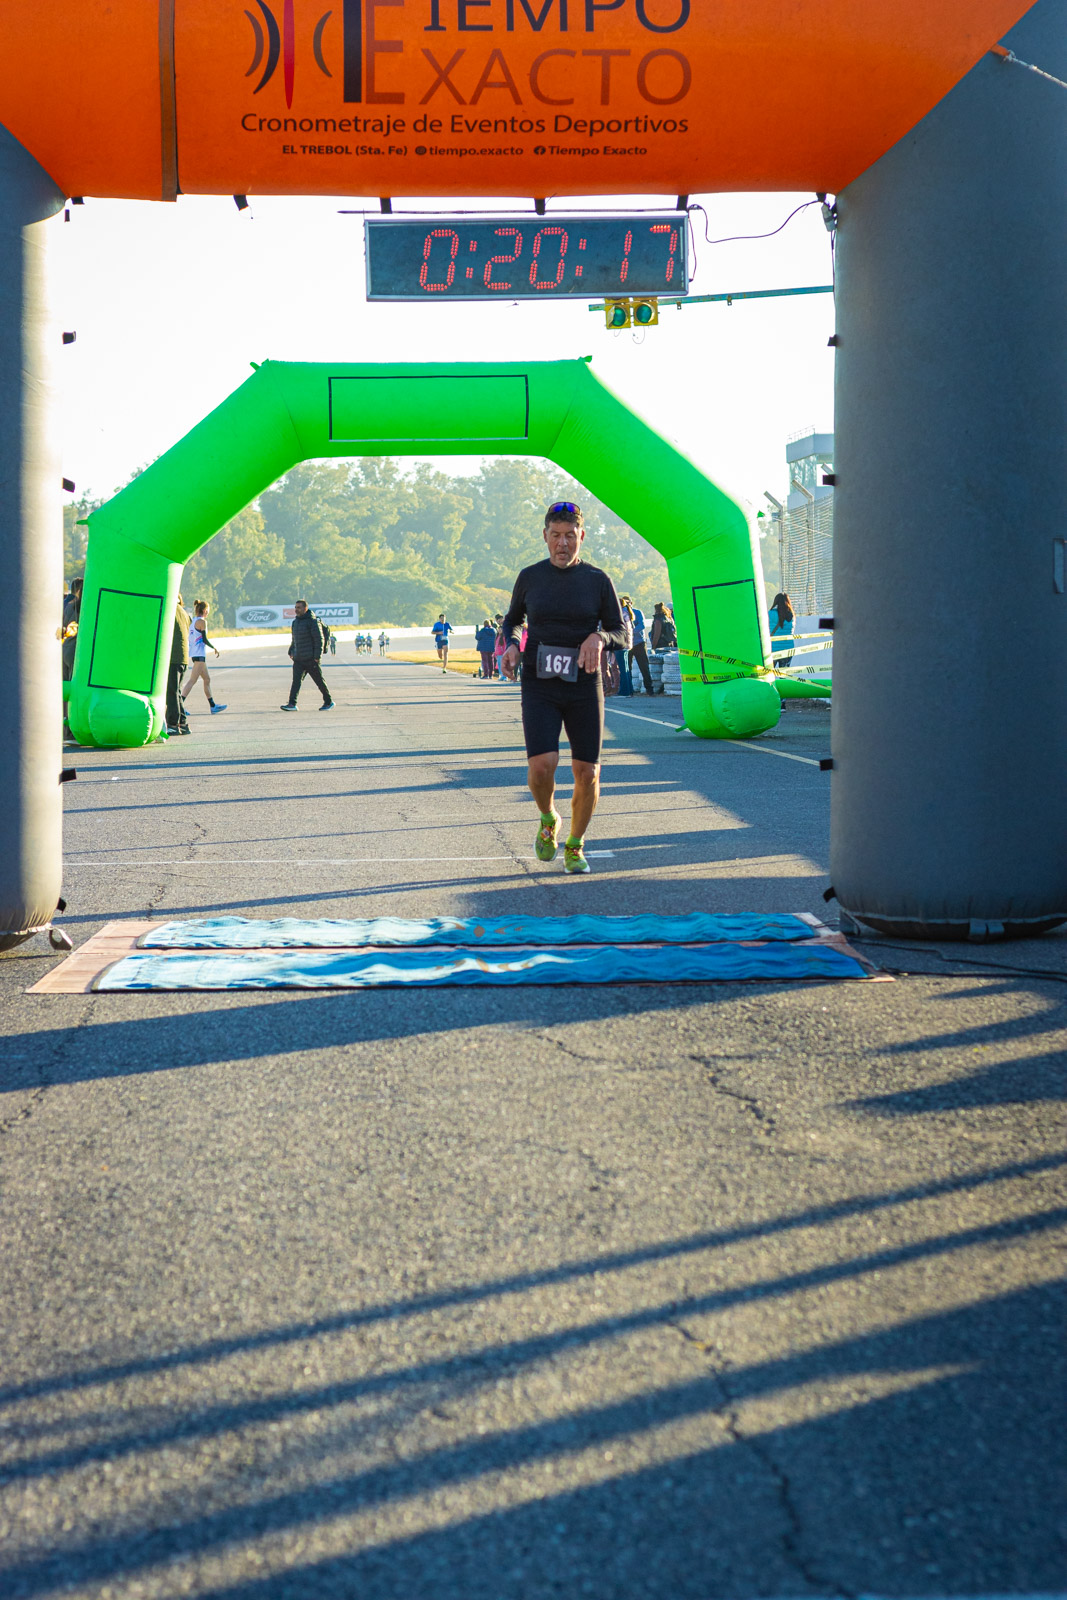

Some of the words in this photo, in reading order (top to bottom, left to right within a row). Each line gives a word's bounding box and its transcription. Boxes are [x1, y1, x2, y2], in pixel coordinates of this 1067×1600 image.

[241, 114, 405, 137] Cronometraje
[413, 114, 443, 133] de
[451, 115, 546, 133] Eventos
[554, 115, 689, 137] Deportivos
[282, 145, 298, 155] EL
[300, 145, 353, 155] TREBOL
[355, 145, 385, 157] (Sta.
[387, 145, 408, 157] Fe)
[428, 146, 524, 158] tiempo.exacto
[548, 146, 599, 158] Tiempo
[602, 146, 648, 156] Exacto
[419, 224, 678, 291] 0:20:17
[246, 611, 270, 622] Ford
[545, 653, 572, 675] 167
